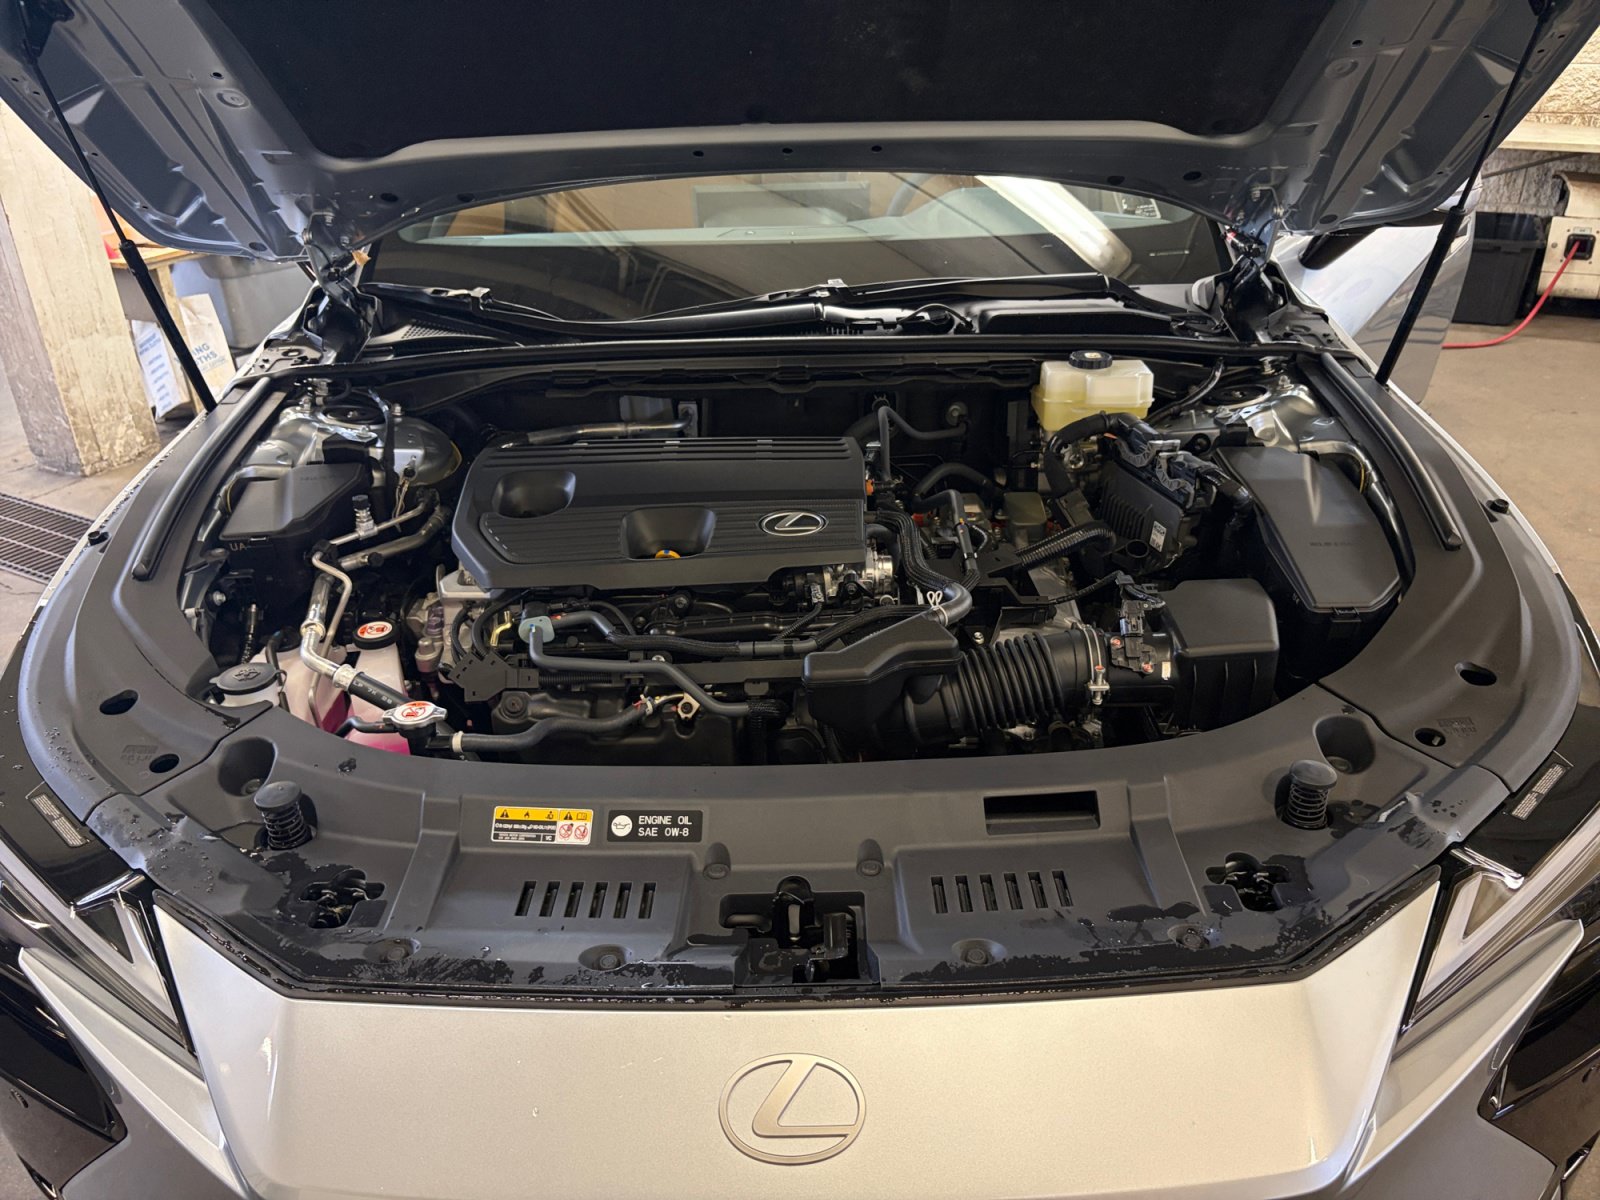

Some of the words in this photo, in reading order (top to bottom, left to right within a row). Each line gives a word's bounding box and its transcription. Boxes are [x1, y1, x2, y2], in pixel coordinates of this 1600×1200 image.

[638, 815, 672, 825] ENGINE
[677, 815, 693, 825] OIL
[638, 827, 659, 837] SAE
[664, 827, 689, 837] 0W-8
